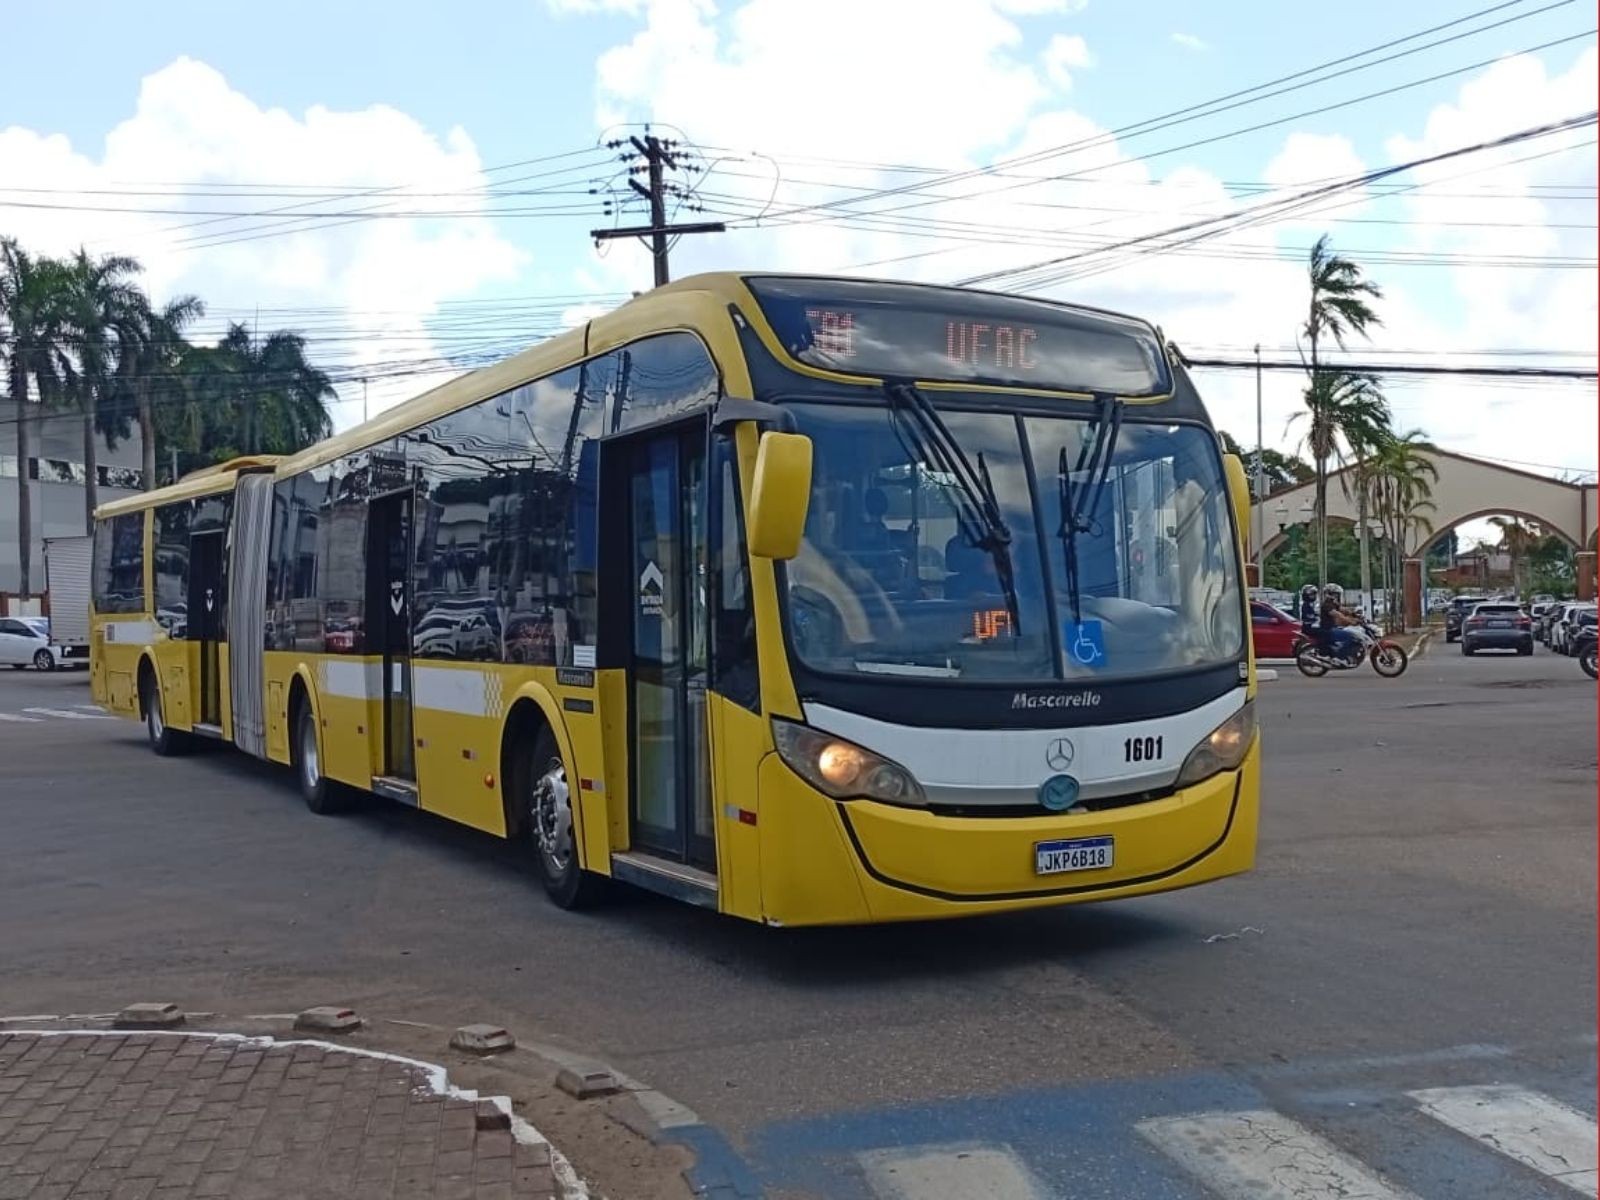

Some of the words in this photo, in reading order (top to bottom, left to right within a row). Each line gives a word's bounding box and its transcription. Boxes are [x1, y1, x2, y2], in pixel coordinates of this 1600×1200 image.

[946, 322, 1038, 370] UFAC
[1011, 691, 1101, 709] Mascarello
[1124, 735, 1163, 763] 1601
[1044, 848, 1106, 871] JKP6B18
